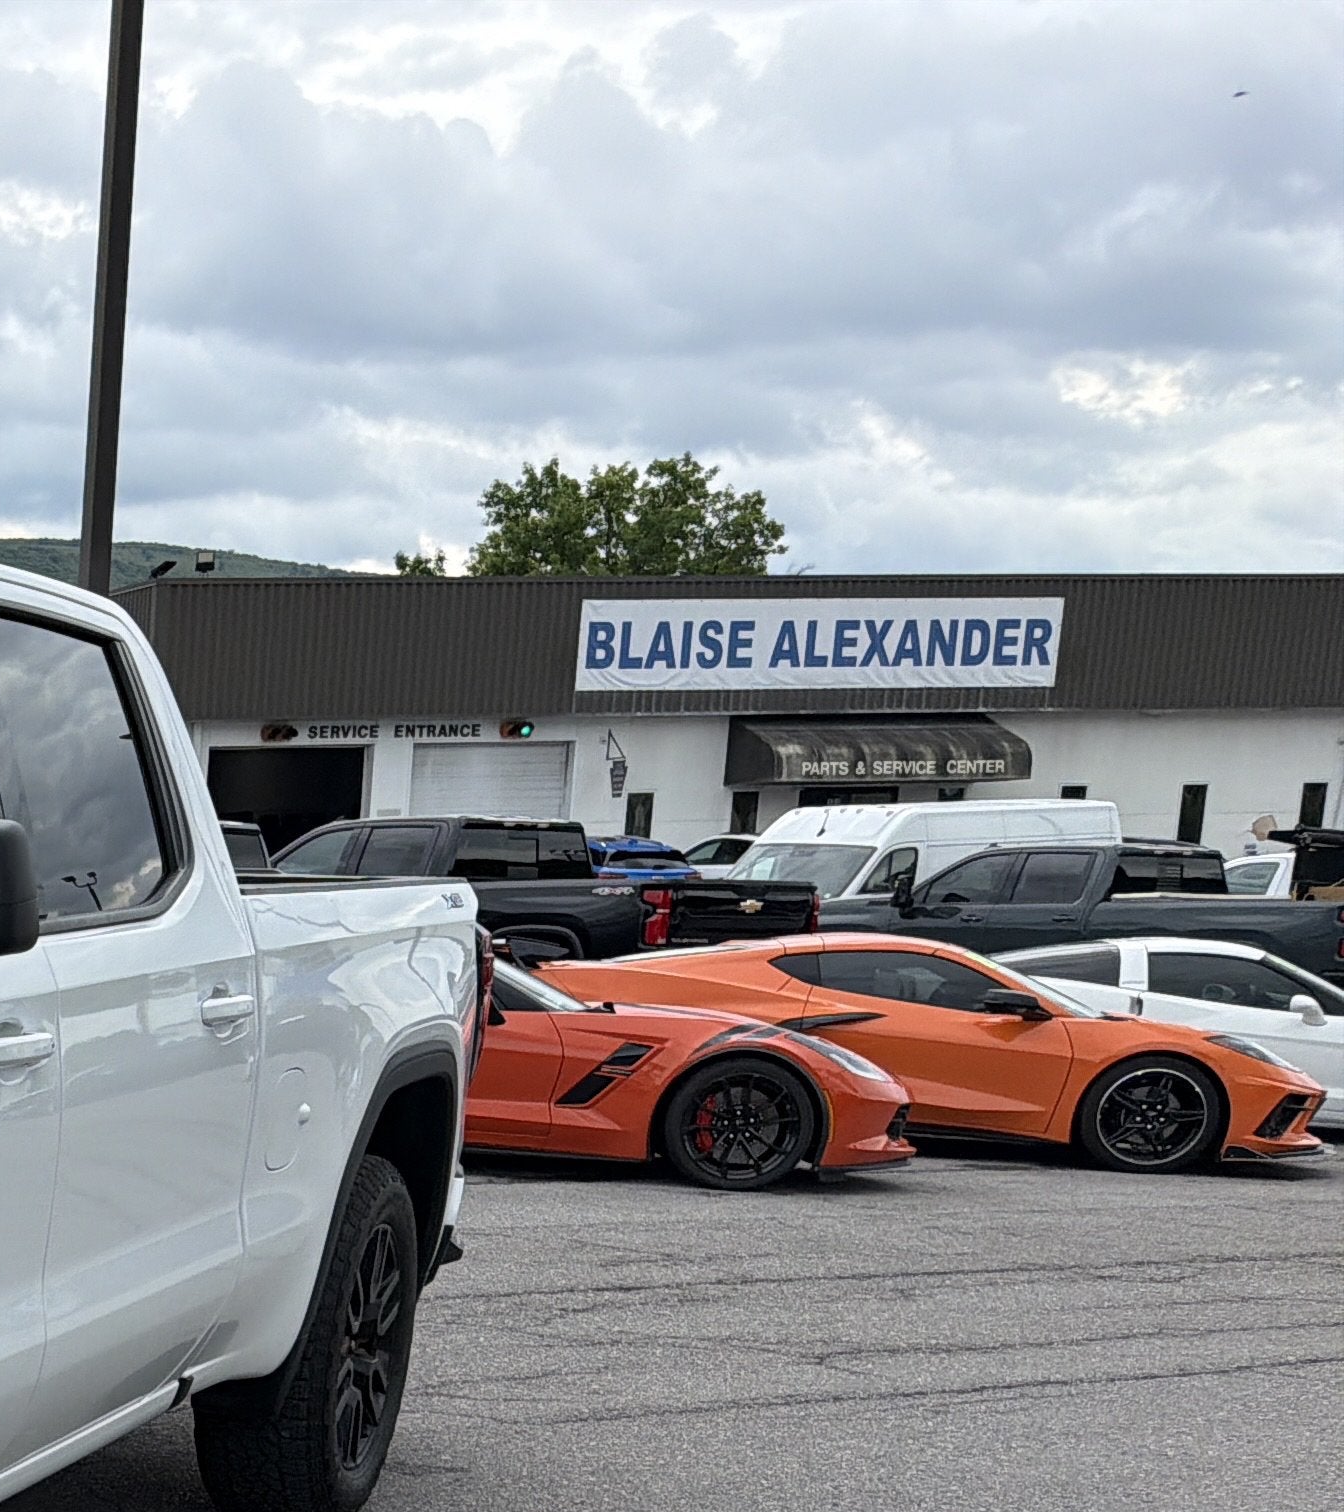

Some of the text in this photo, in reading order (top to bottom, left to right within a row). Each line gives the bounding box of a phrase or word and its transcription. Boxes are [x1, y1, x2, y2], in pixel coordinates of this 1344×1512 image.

[585, 618, 1053, 669] BLAISE ALEXANDER
[307, 724, 481, 739] SERVICE ENTRANCE
[801, 759, 1005, 776] PARTS & SERVICE CENTER
